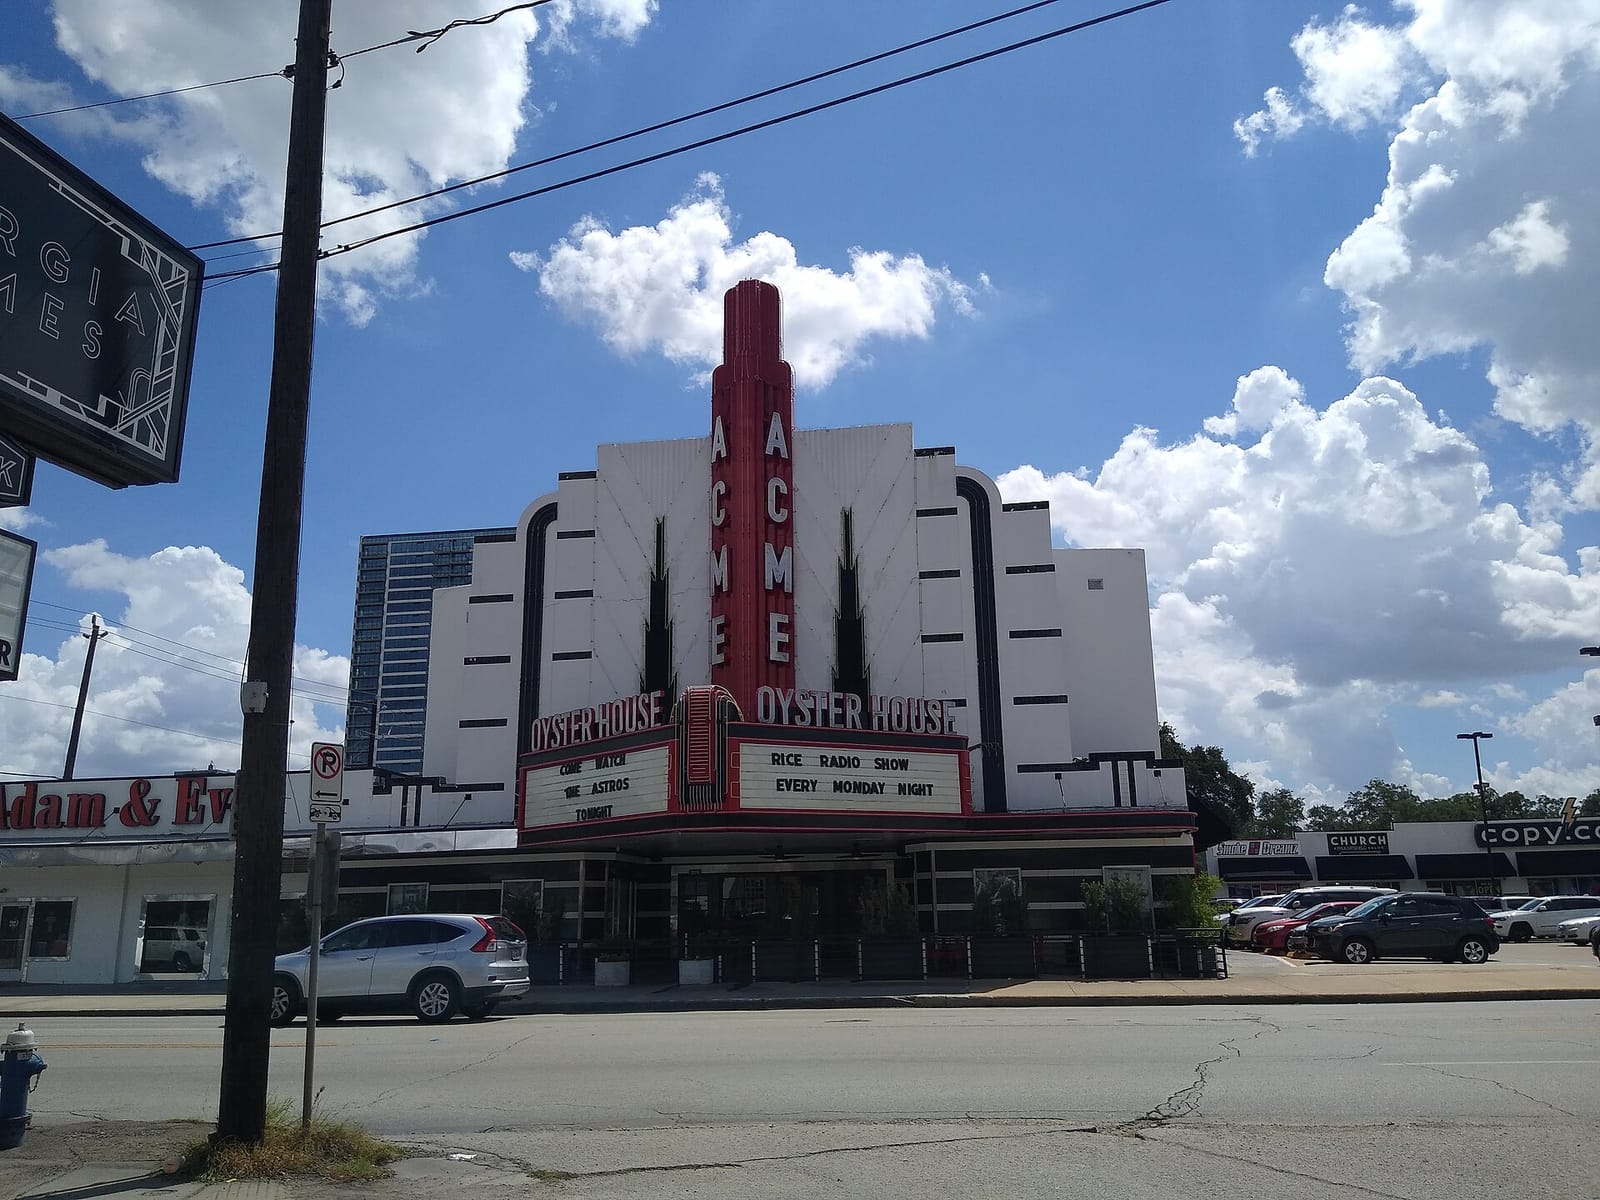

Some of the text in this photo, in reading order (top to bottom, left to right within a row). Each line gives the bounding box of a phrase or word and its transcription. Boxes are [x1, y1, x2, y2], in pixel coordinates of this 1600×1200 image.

[711, 415, 728, 665] ACME
[765, 412, 792, 662] ACME
[531, 690, 664, 751] OYSTER HOUSE
[757, 685, 958, 735] OYSTER HOUSE
[559, 754, 626, 776] COME WATCH
[771, 752, 909, 771] RICE RADIO SHOW
[564, 778, 629, 799] THE ASTROS
[776, 778, 934, 796] EVERY MONDAY NIGHT
[0, 776, 235, 830] dam & Ev
[576, 805, 613, 821] TONIGHT
[1262, 842, 1299, 855] Dreamz
[1330, 835, 1387, 846] CHURCH
